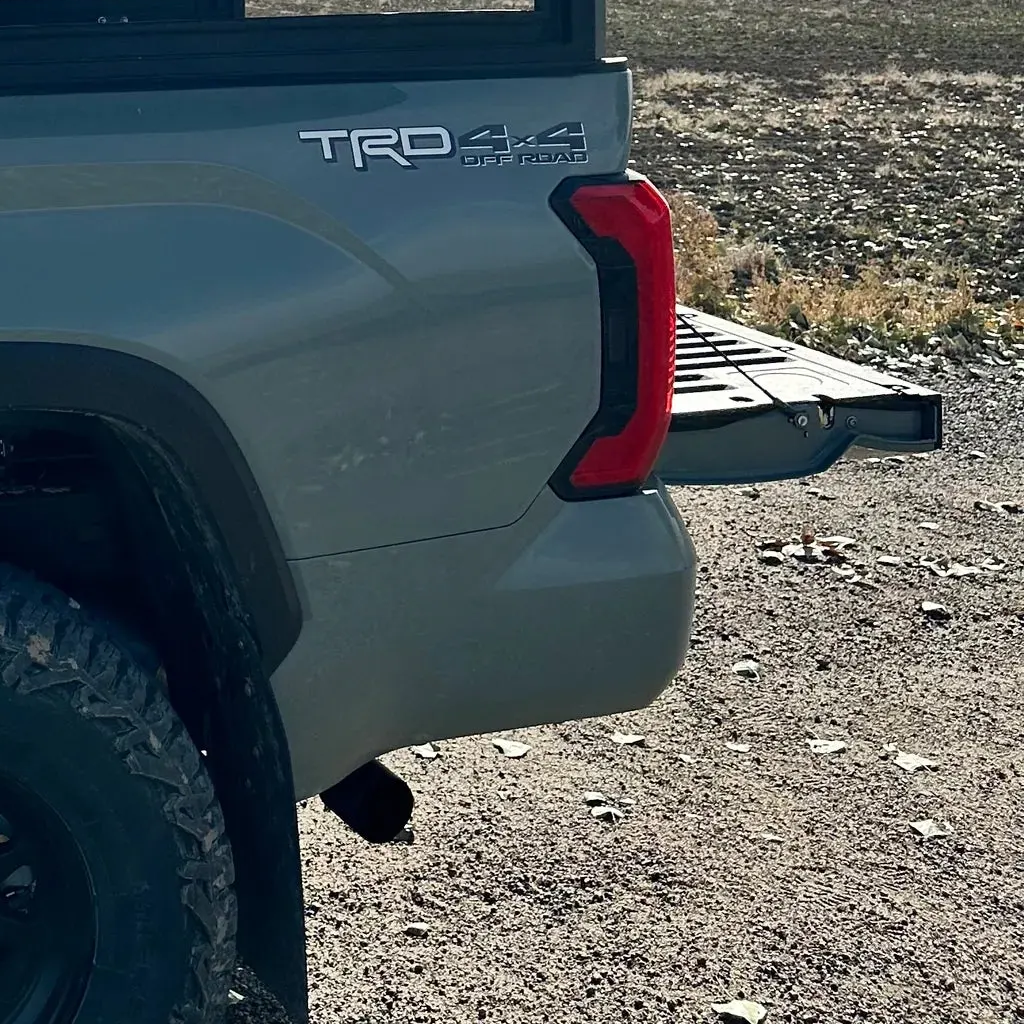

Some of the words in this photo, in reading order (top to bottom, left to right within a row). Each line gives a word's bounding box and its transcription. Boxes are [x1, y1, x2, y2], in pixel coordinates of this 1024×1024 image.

[298, 125, 455, 170] TRD
[458, 122, 588, 153] 4x4
[461, 154, 513, 167] OFF
[519, 152, 589, 165] ROAD
